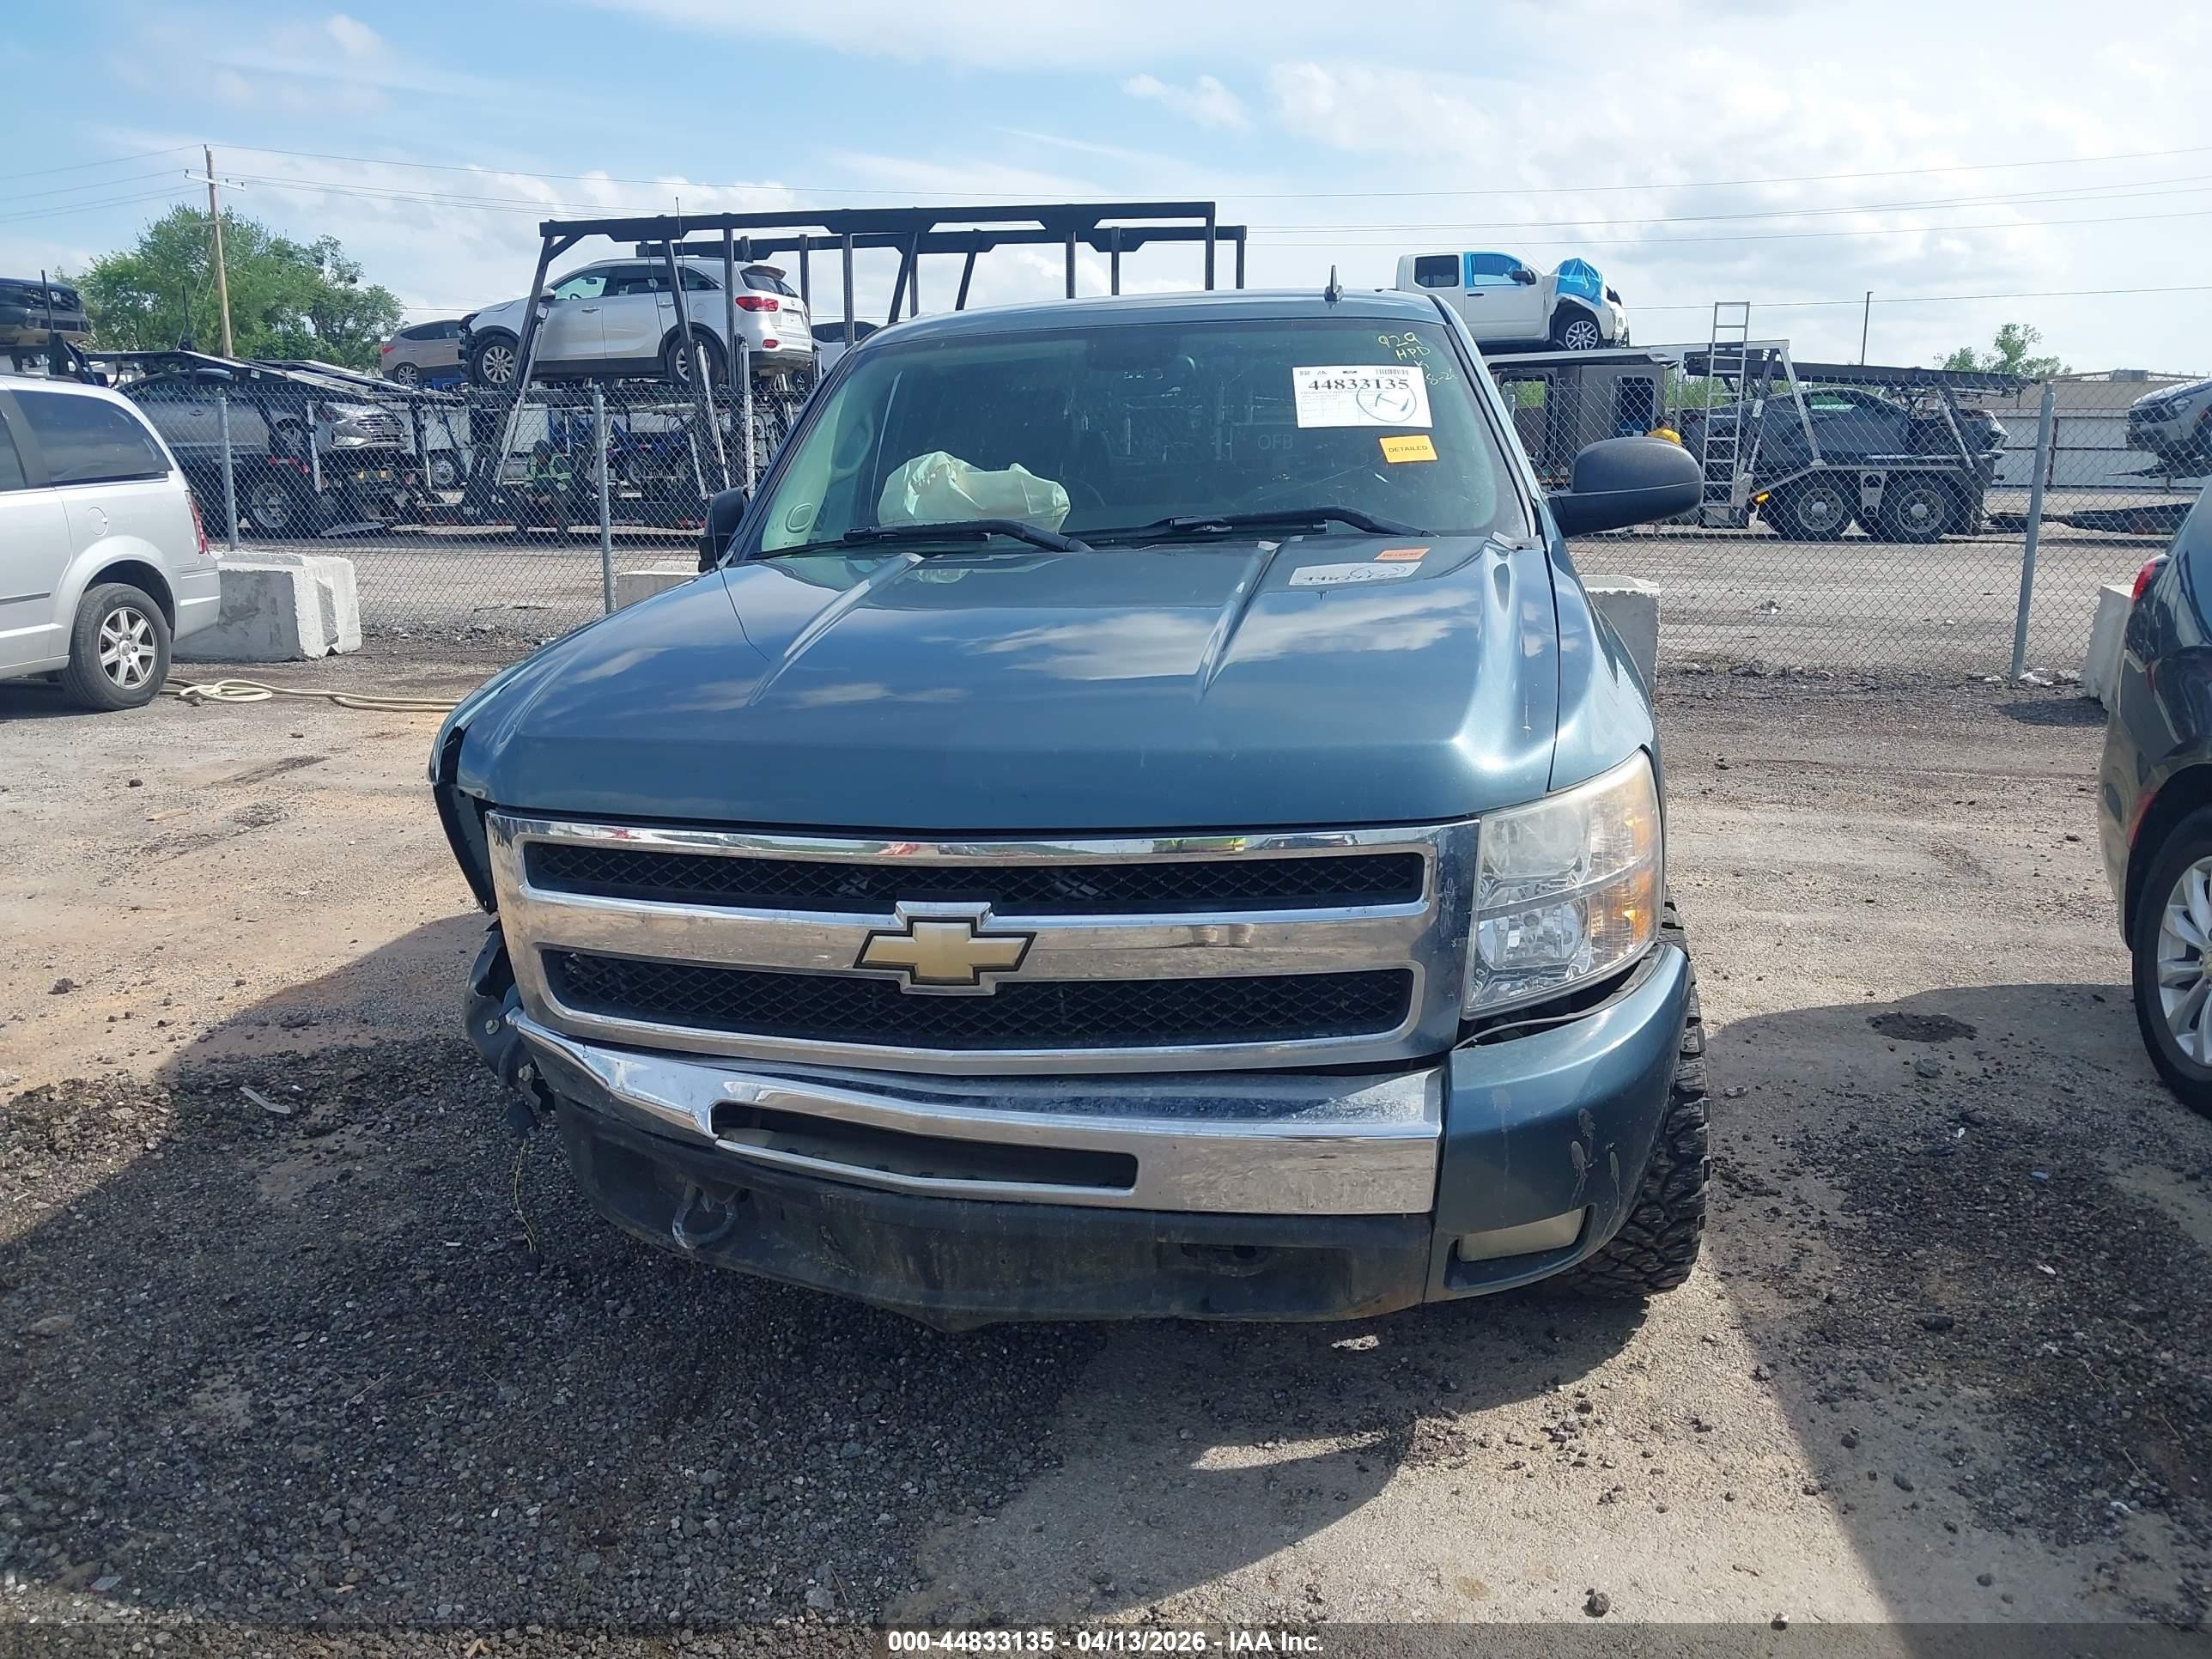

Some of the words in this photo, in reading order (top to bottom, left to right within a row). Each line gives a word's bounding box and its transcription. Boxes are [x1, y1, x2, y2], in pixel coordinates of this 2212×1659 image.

[1377, 331, 1423, 349] 929
[1395, 346, 1431, 361] HPD
[1308, 378, 1409, 391] 44833135
[1388, 445, 1429, 453] DETAILED
